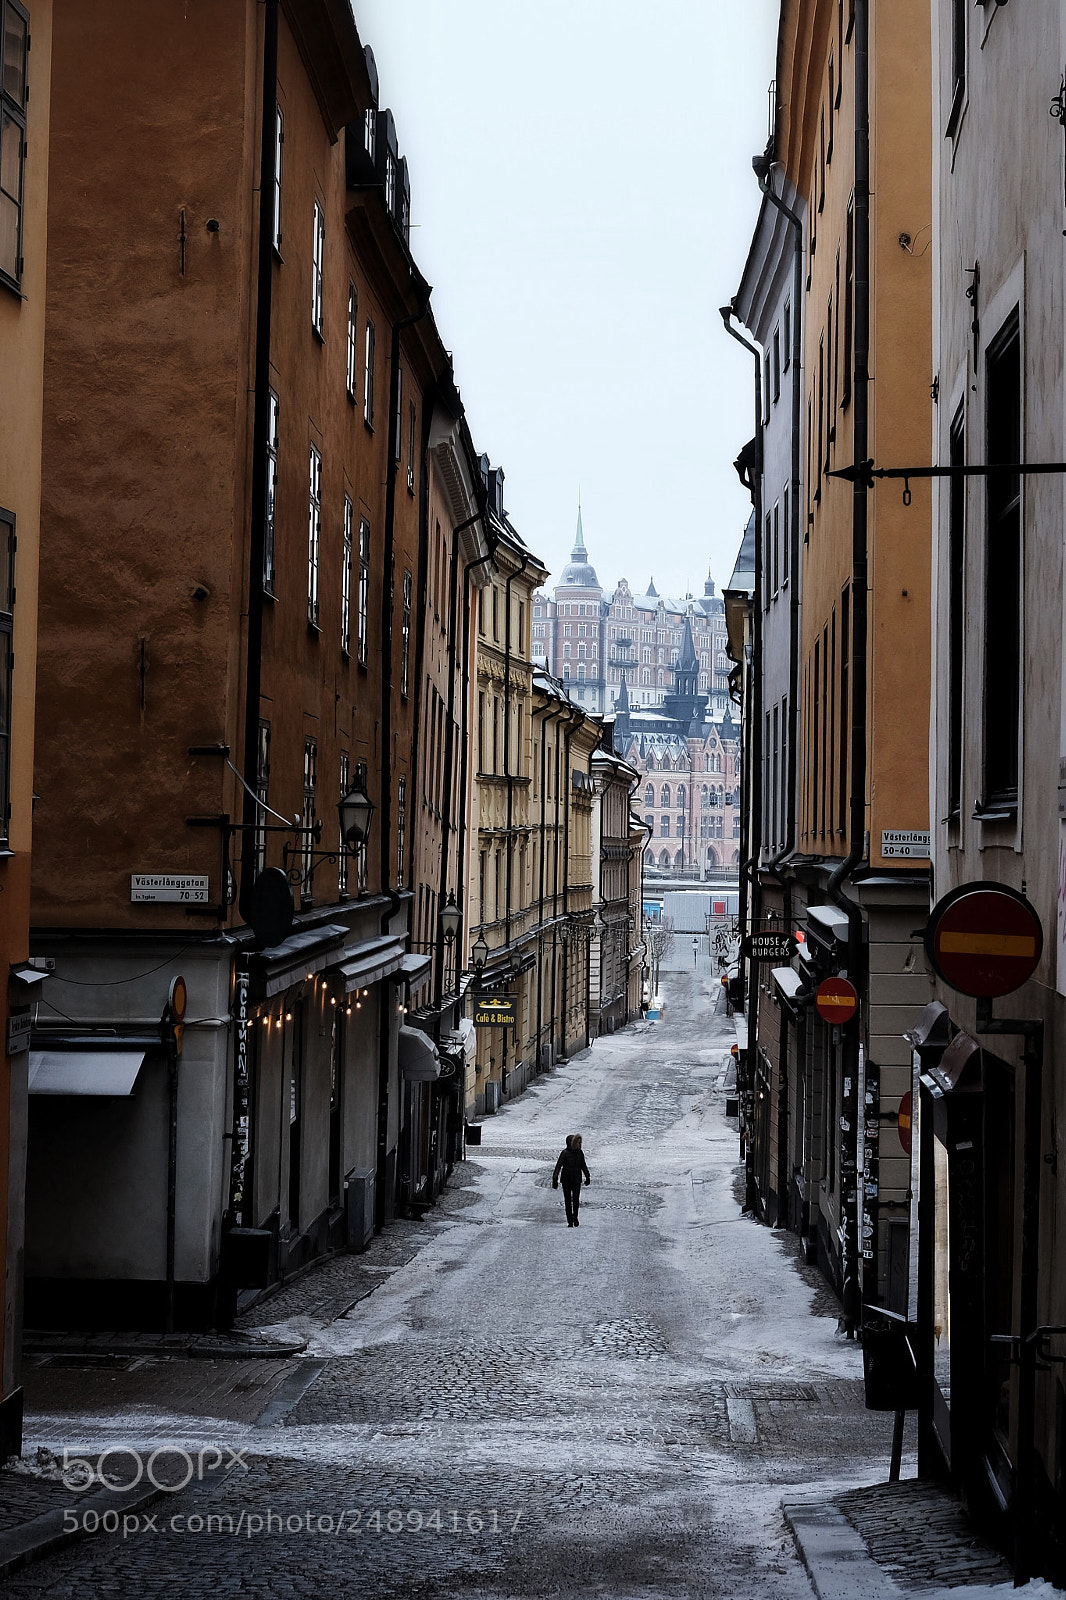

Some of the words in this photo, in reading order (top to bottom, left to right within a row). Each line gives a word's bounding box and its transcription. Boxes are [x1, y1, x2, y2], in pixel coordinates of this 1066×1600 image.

[135, 877, 204, 888] Västerlånggatan
[752, 937, 780, 946] HOUSE
[782, 938, 790, 949] of
[752, 948, 790, 957] BURGERS
[491, 1013, 496, 1023] &
[497, 1014, 515, 1024] Bistro
